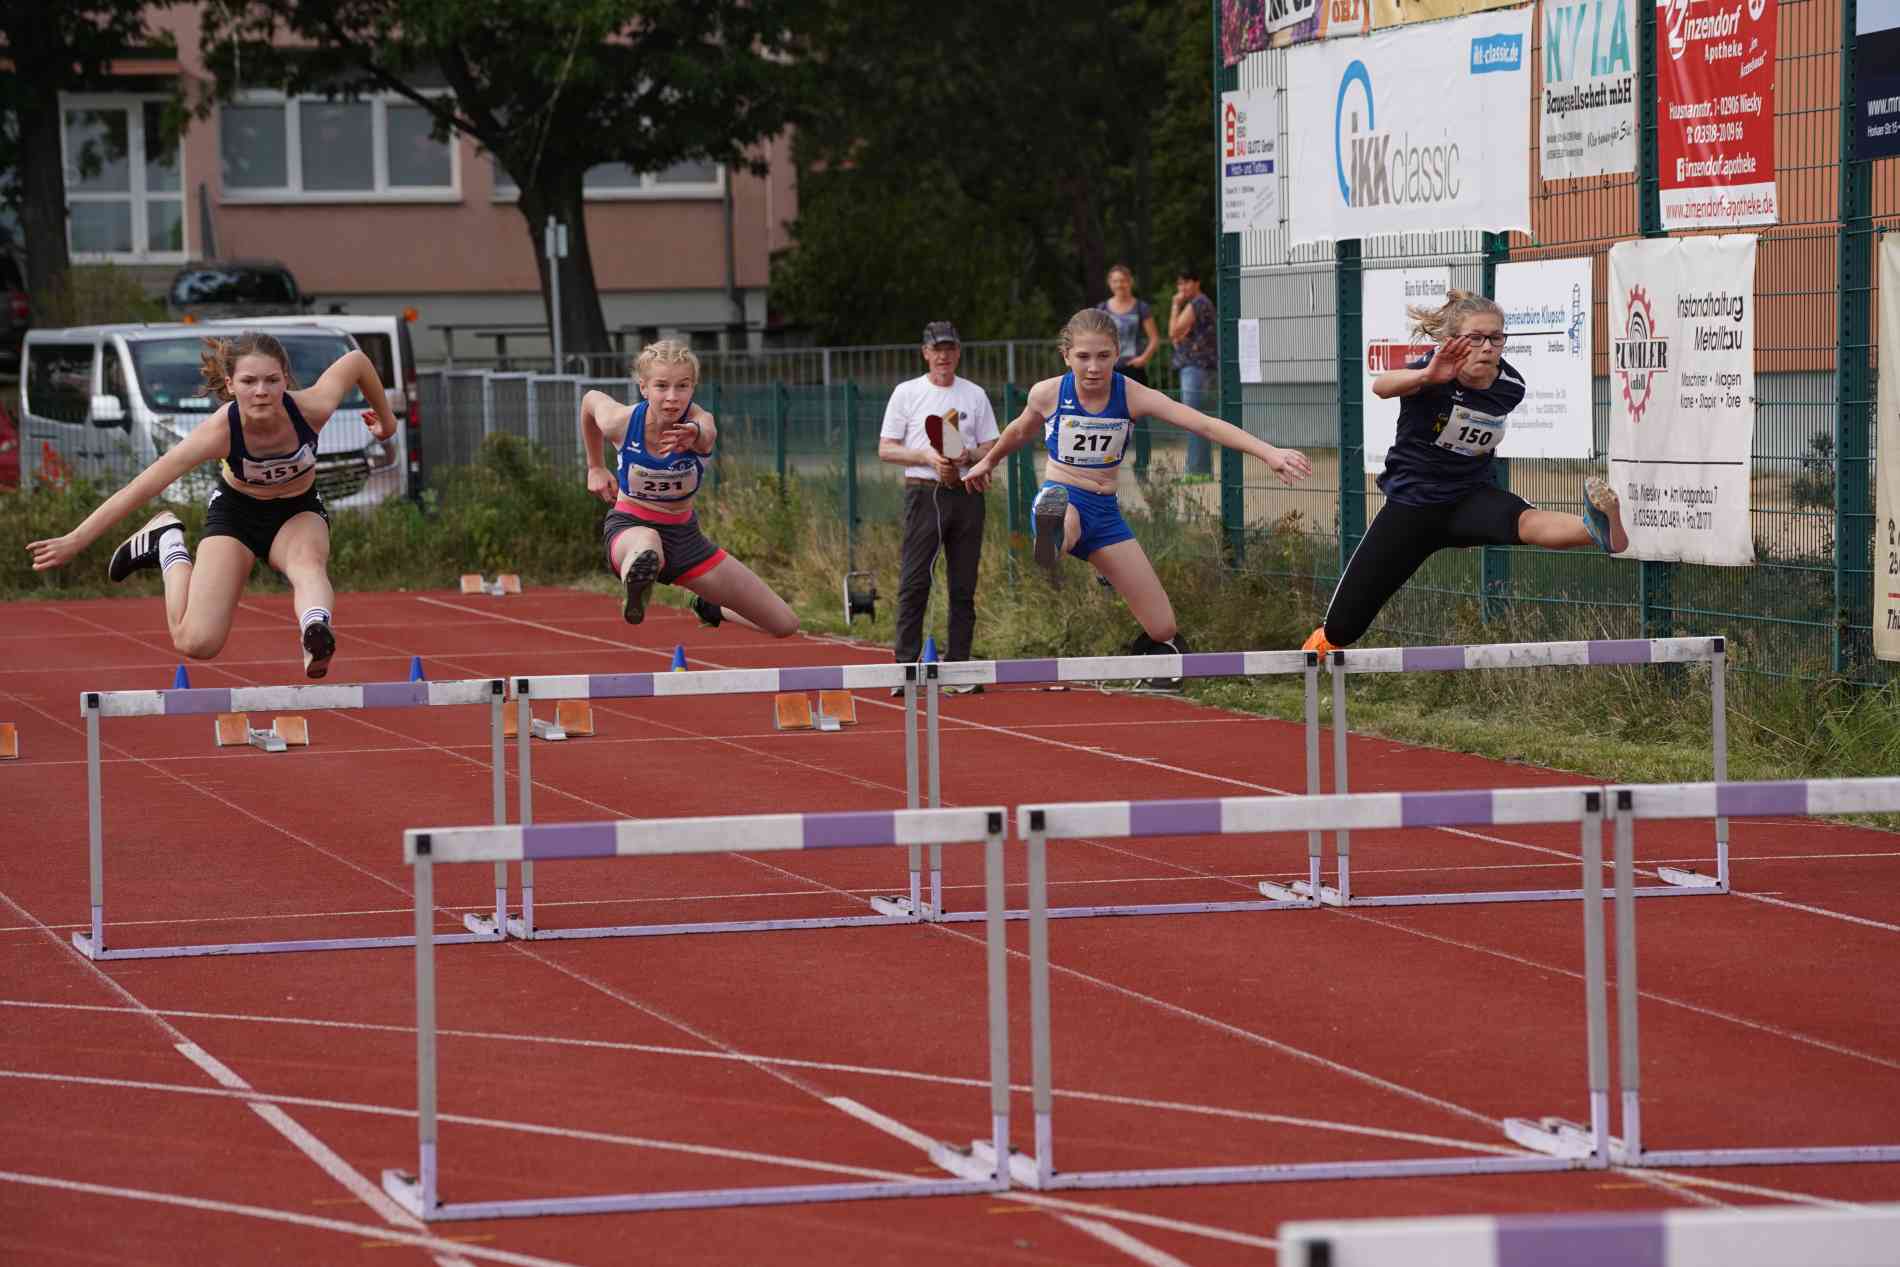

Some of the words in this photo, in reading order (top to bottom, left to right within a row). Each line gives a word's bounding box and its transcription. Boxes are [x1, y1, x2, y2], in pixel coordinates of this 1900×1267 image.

[1705, 40, 1743, 64] Apotheke
[1546, 82, 1607, 119] Baugesellschaft
[1609, 78, 1632, 105] mbH
[1391, 128, 1460, 205] classic
[1695, 325, 1743, 351] Metallbau
[1725, 392, 1741, 408] Tore
[1073, 434, 1112, 451] 217
[1459, 426, 1493, 446] 150
[262, 465, 298, 480] 151
[643, 480, 682, 492] 231
